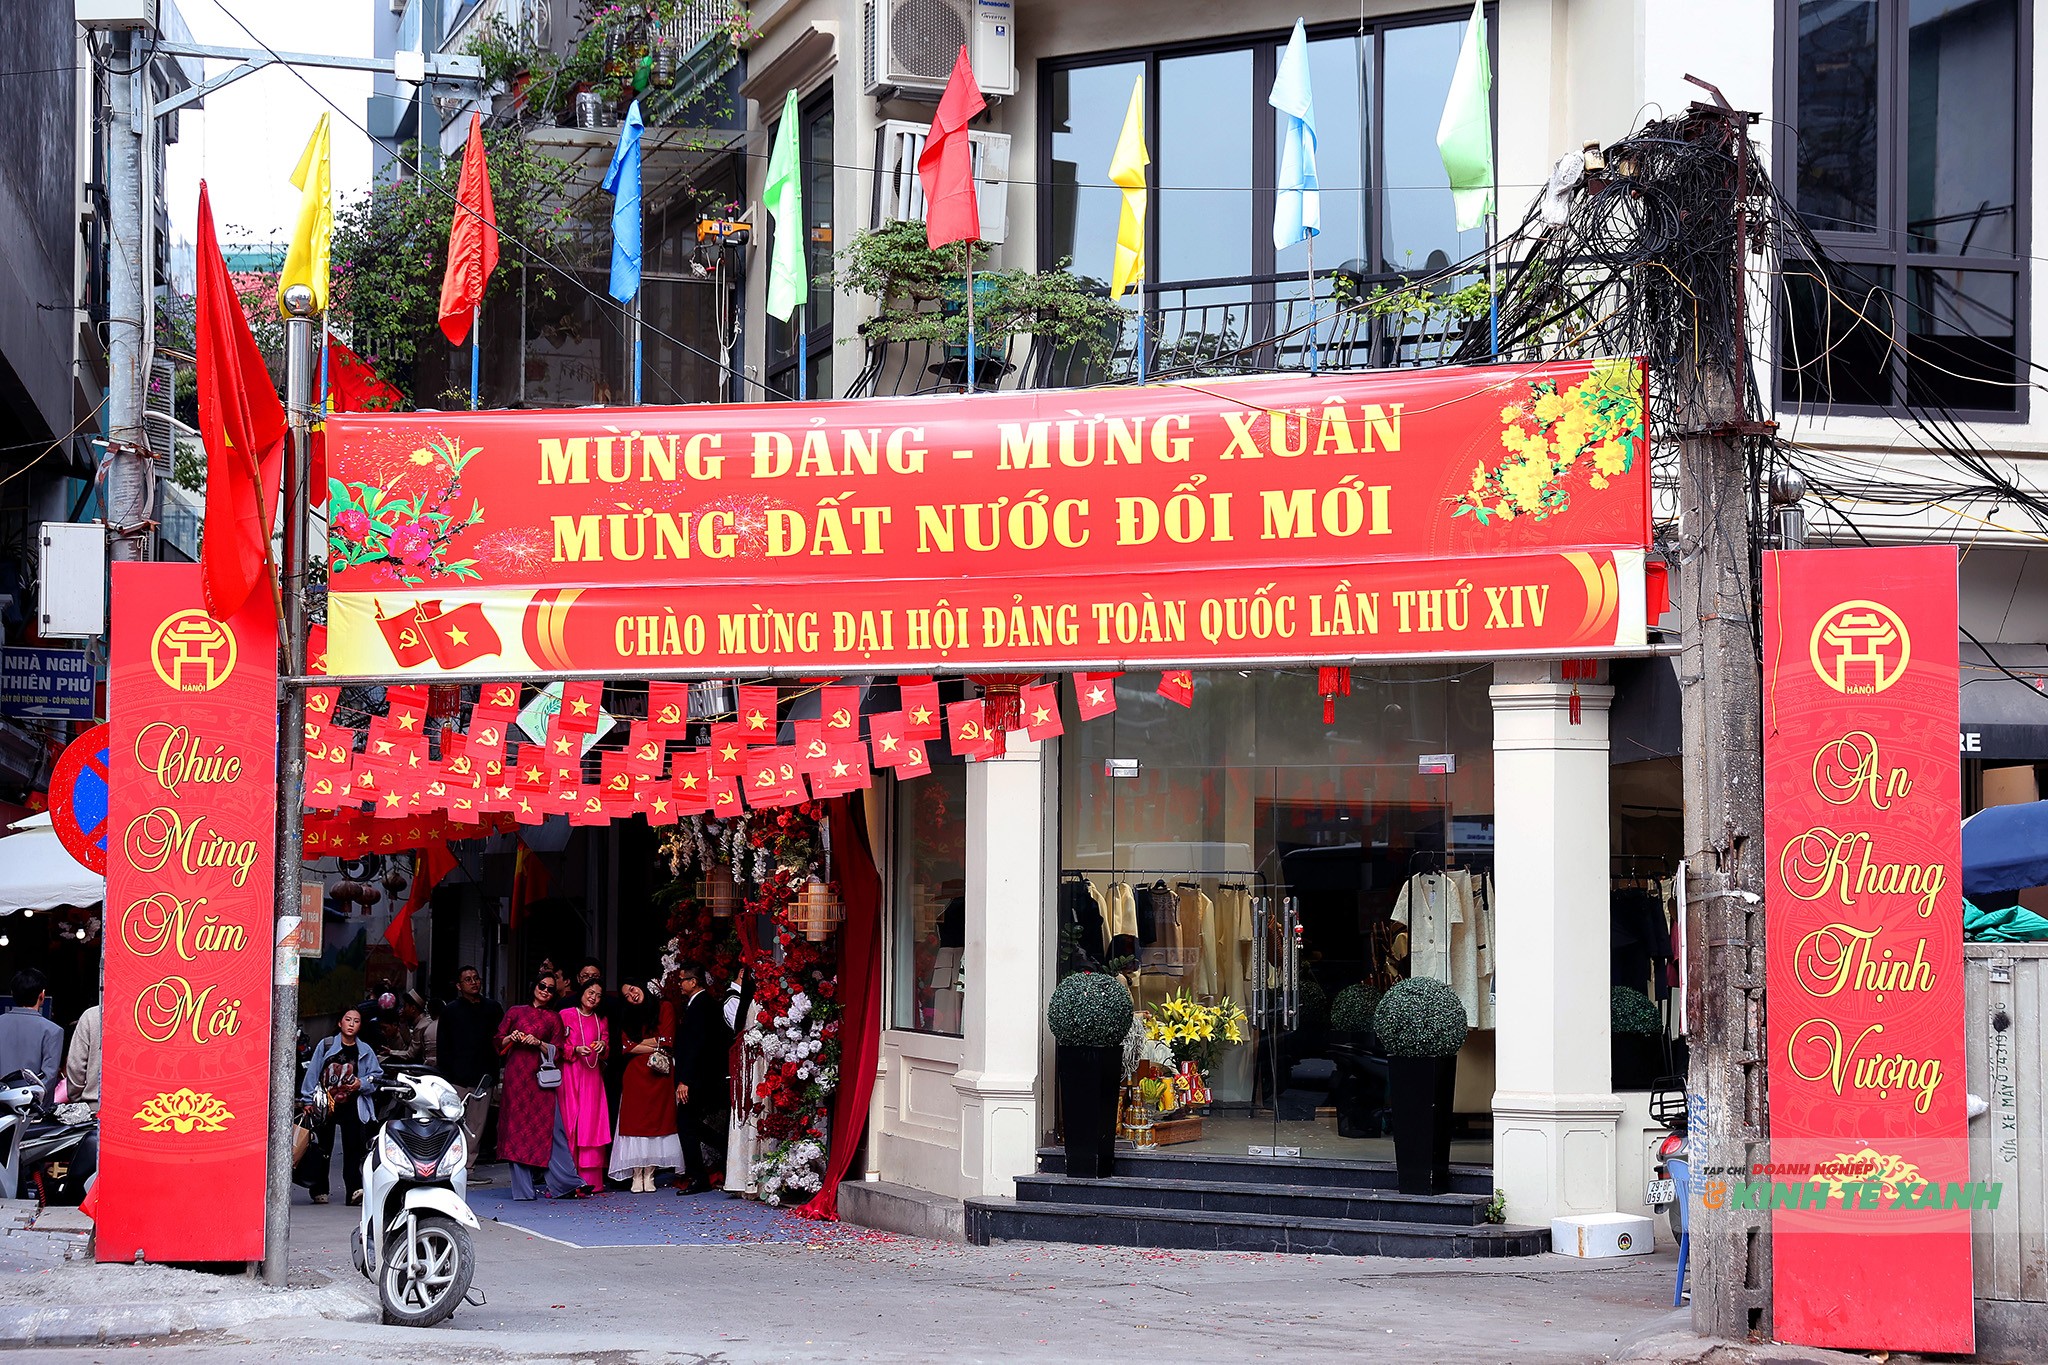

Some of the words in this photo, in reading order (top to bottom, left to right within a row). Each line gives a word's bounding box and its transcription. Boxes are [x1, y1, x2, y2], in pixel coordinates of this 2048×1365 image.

[979, 0, 1010, 8] Panasonic
[538, 425, 727, 485] MỪNG
[750, 417, 929, 478] ĐẢNG
[997, 409, 1195, 470] MỪNG
[1219, 395, 1404, 460] XUÂN
[551, 503, 739, 562] MỪNG
[764, 491, 892, 557] ĐẤT
[915, 489, 1090, 553] NƯỚC
[1116, 473, 1234, 545] ĐỔI
[1260, 474, 1393, 539] MỚI
[614, 607, 706, 656] CHÀO
[718, 604, 819, 655] MỪNG
[832, 610, 894, 659] ĐẠI
[907, 598, 970, 657] HỘI
[982, 593, 1080, 648] ĐẢNG
[1092, 592, 1187, 644] TOÀN
[1199, 582, 1296, 646] QUỐC
[1309, 579, 1380, 637] LẦN
[1392, 578, 1474, 634] THỨ
[1483, 584, 1550, 629] XIV
[1, 673, 51, 691] THIÊN
[56, 676, 91, 692] PHÚ
[5, 653, 40, 670] NHÀ
[181, 683, 206, 694] HÀNỘI
[1846, 684, 1875, 696] HÀNỘI
[135, 721, 243, 799] Chúc
[1812, 730, 1913, 810] An
[124, 806, 259, 888] Mừng
[1780, 826, 1947, 918] Khang
[121, 892, 248, 961] Năm
[1794, 923, 1936, 1003] Thịnh
[134, 975, 242, 1044] Mới
[1787, 1018, 1944, 1115] Vượng
[1997, 1083, 2015, 1107] MÁY
